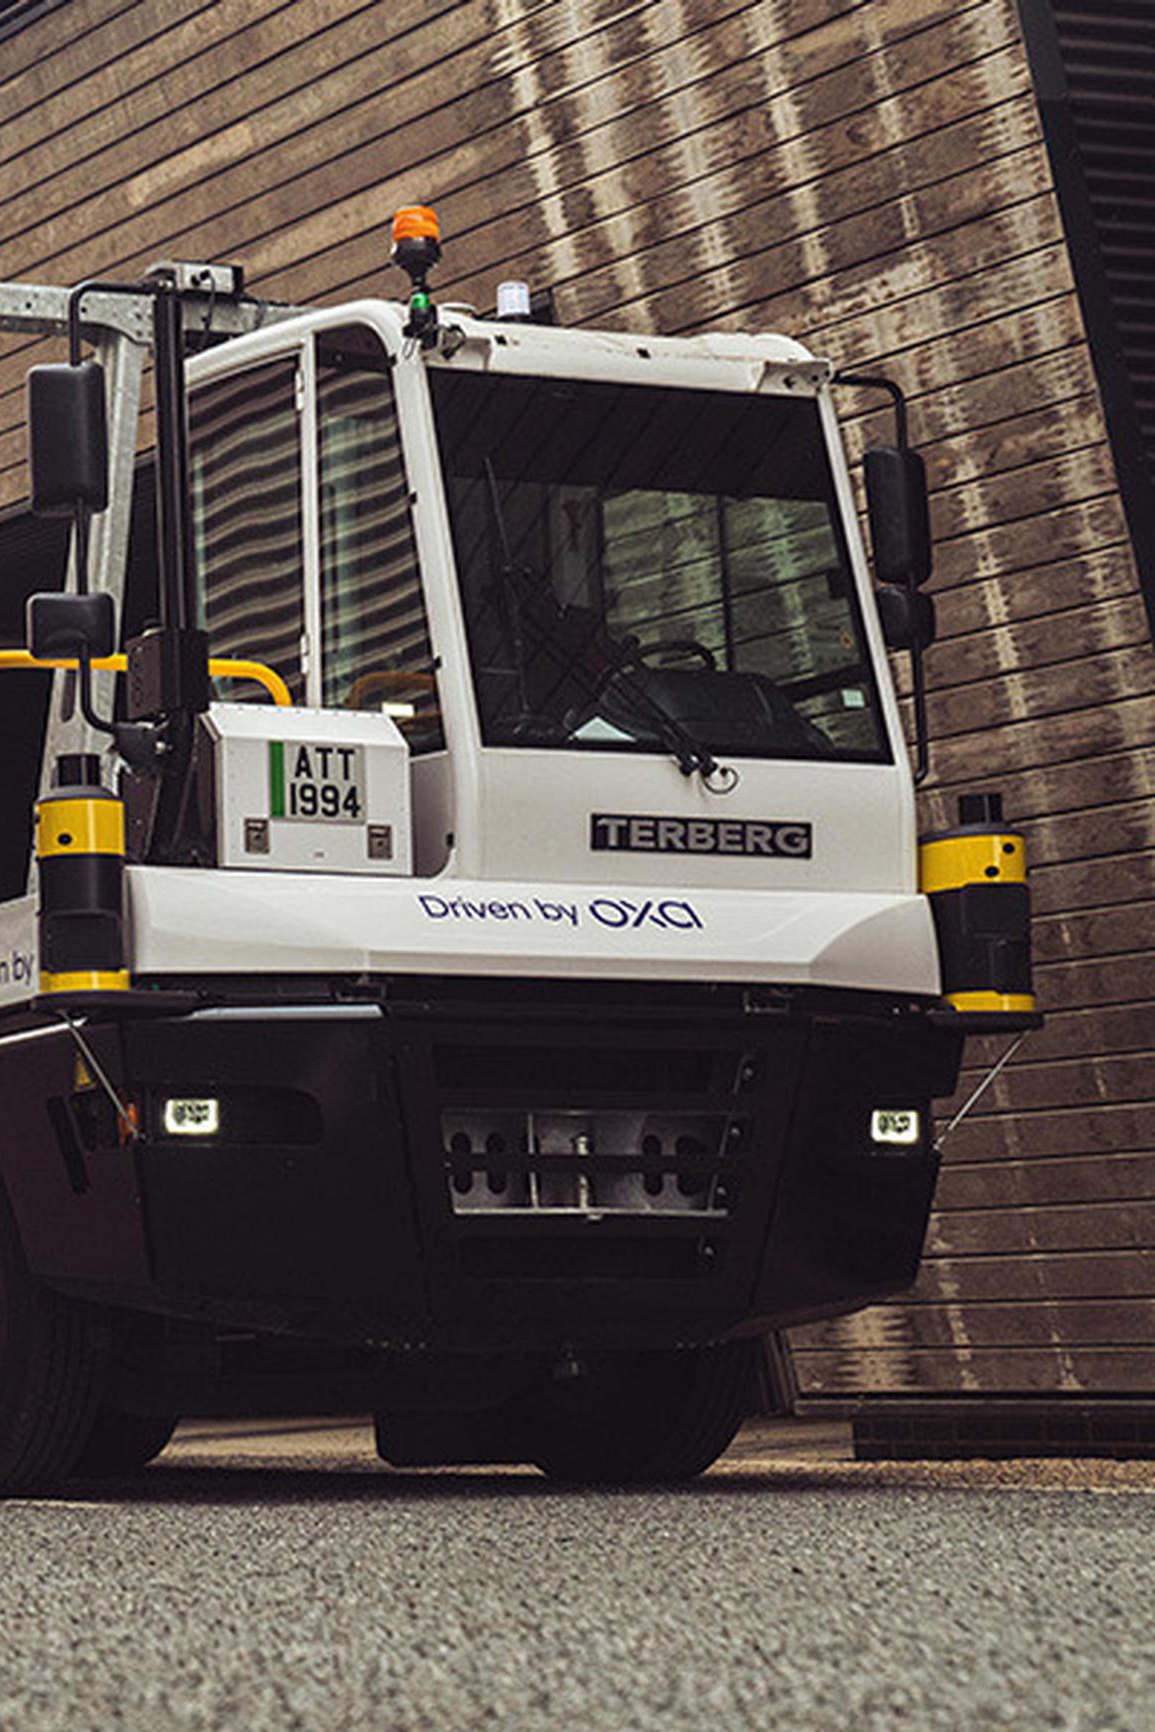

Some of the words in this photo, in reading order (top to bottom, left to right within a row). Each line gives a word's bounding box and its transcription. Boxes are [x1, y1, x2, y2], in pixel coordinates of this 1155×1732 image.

[294, 744, 356, 781] ATT
[289, 782, 362, 819] 1994
[597, 817, 809, 854] TERBERG
[418, 895, 533, 920] Driven
[533, 898, 579, 926] by
[588, 899, 703, 929] oxa
[11, 950, 35, 986] by
